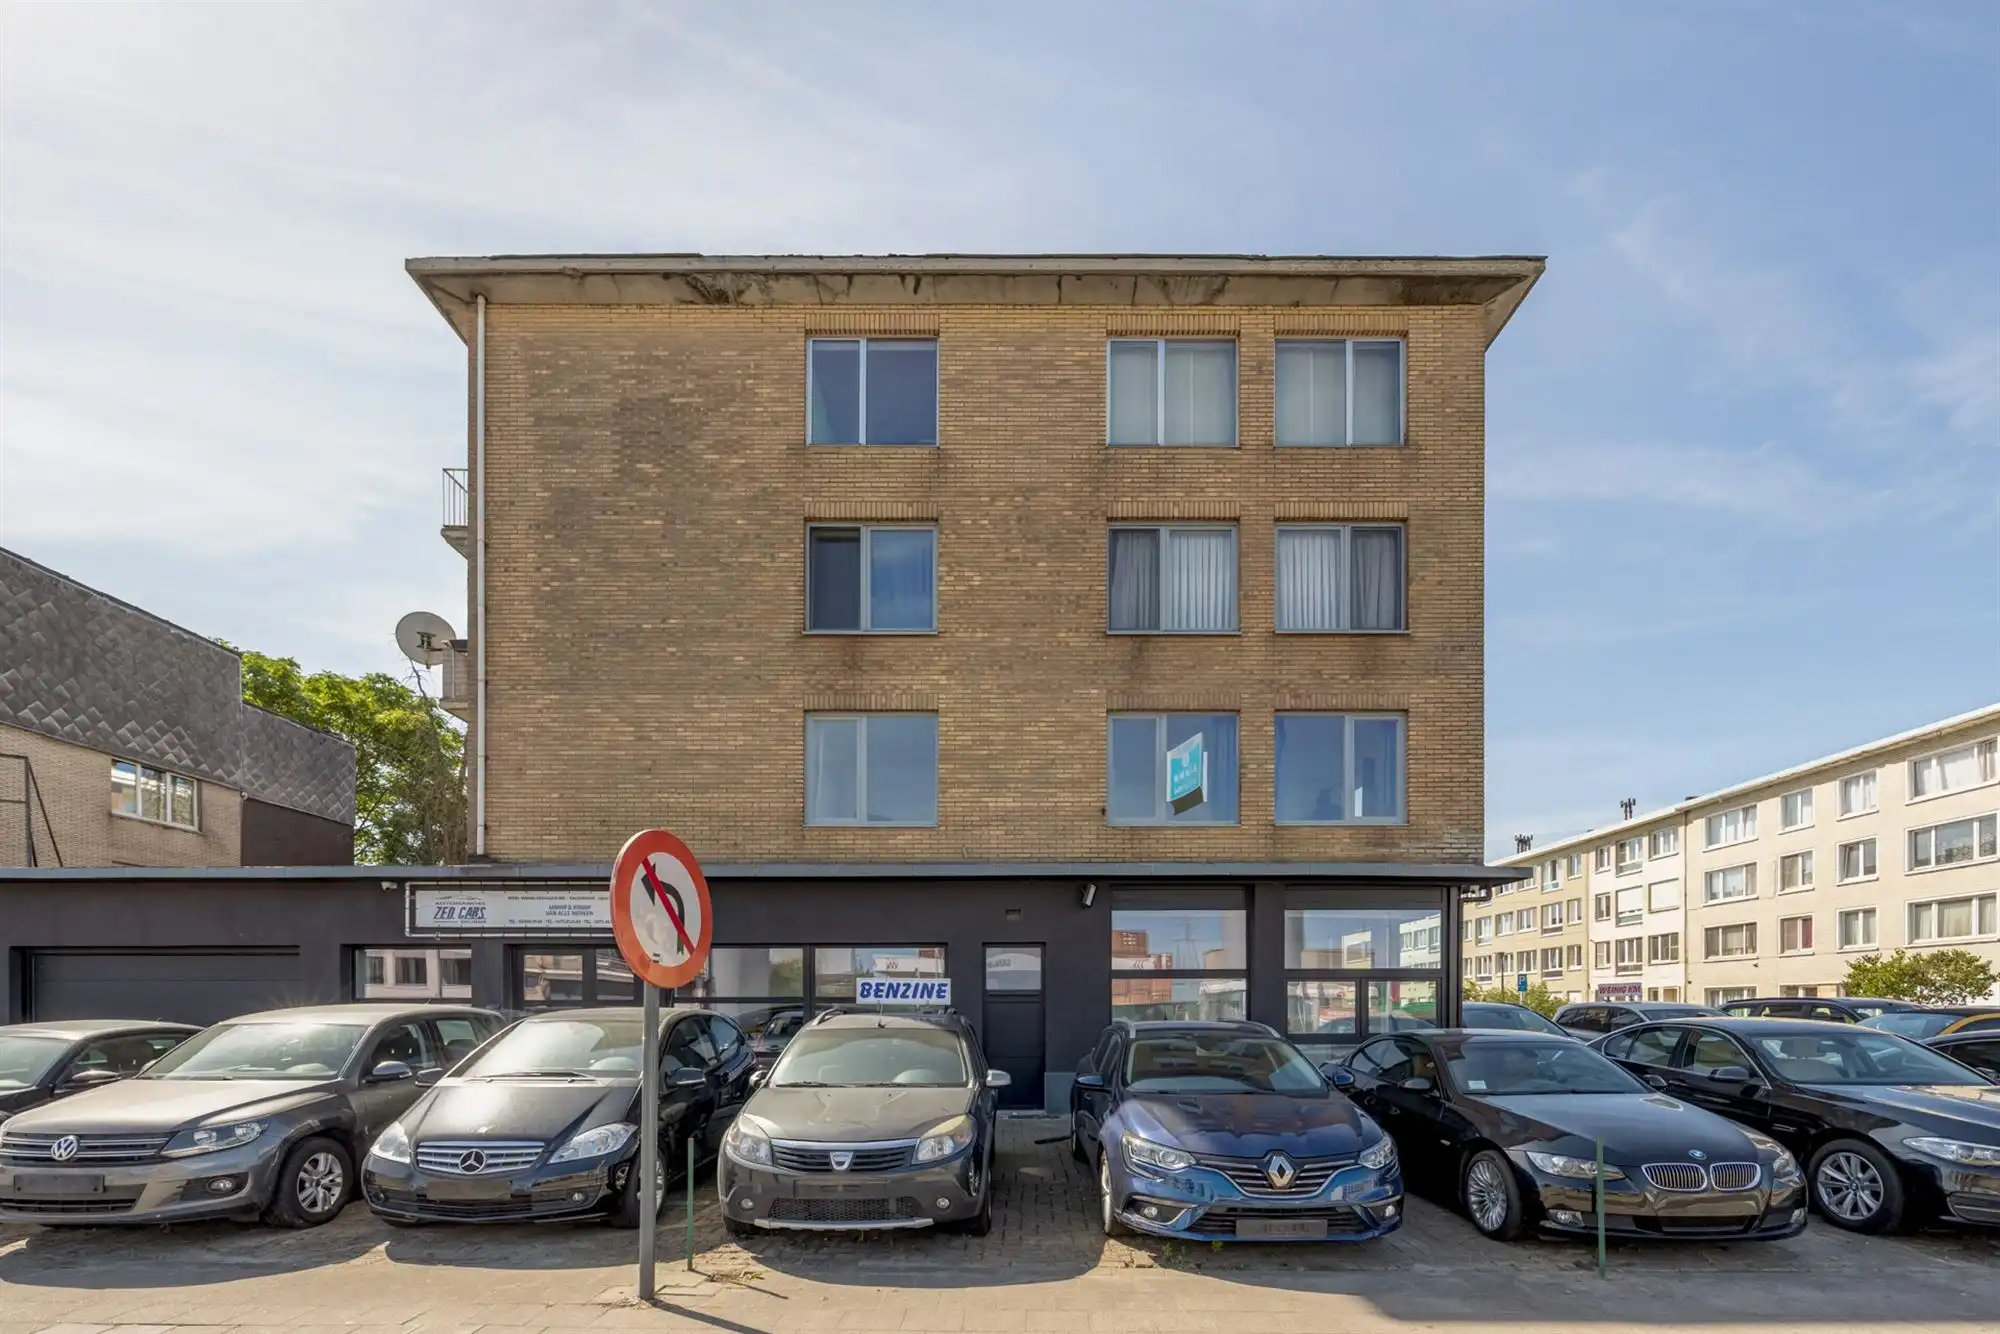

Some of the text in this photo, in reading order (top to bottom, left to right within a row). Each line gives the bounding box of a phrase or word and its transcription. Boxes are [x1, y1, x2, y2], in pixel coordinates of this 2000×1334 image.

[457, 906, 487, 920] CARS
[860, 982, 948, 999] BENZINE
[1599, 985, 1627, 994] WEINIG
